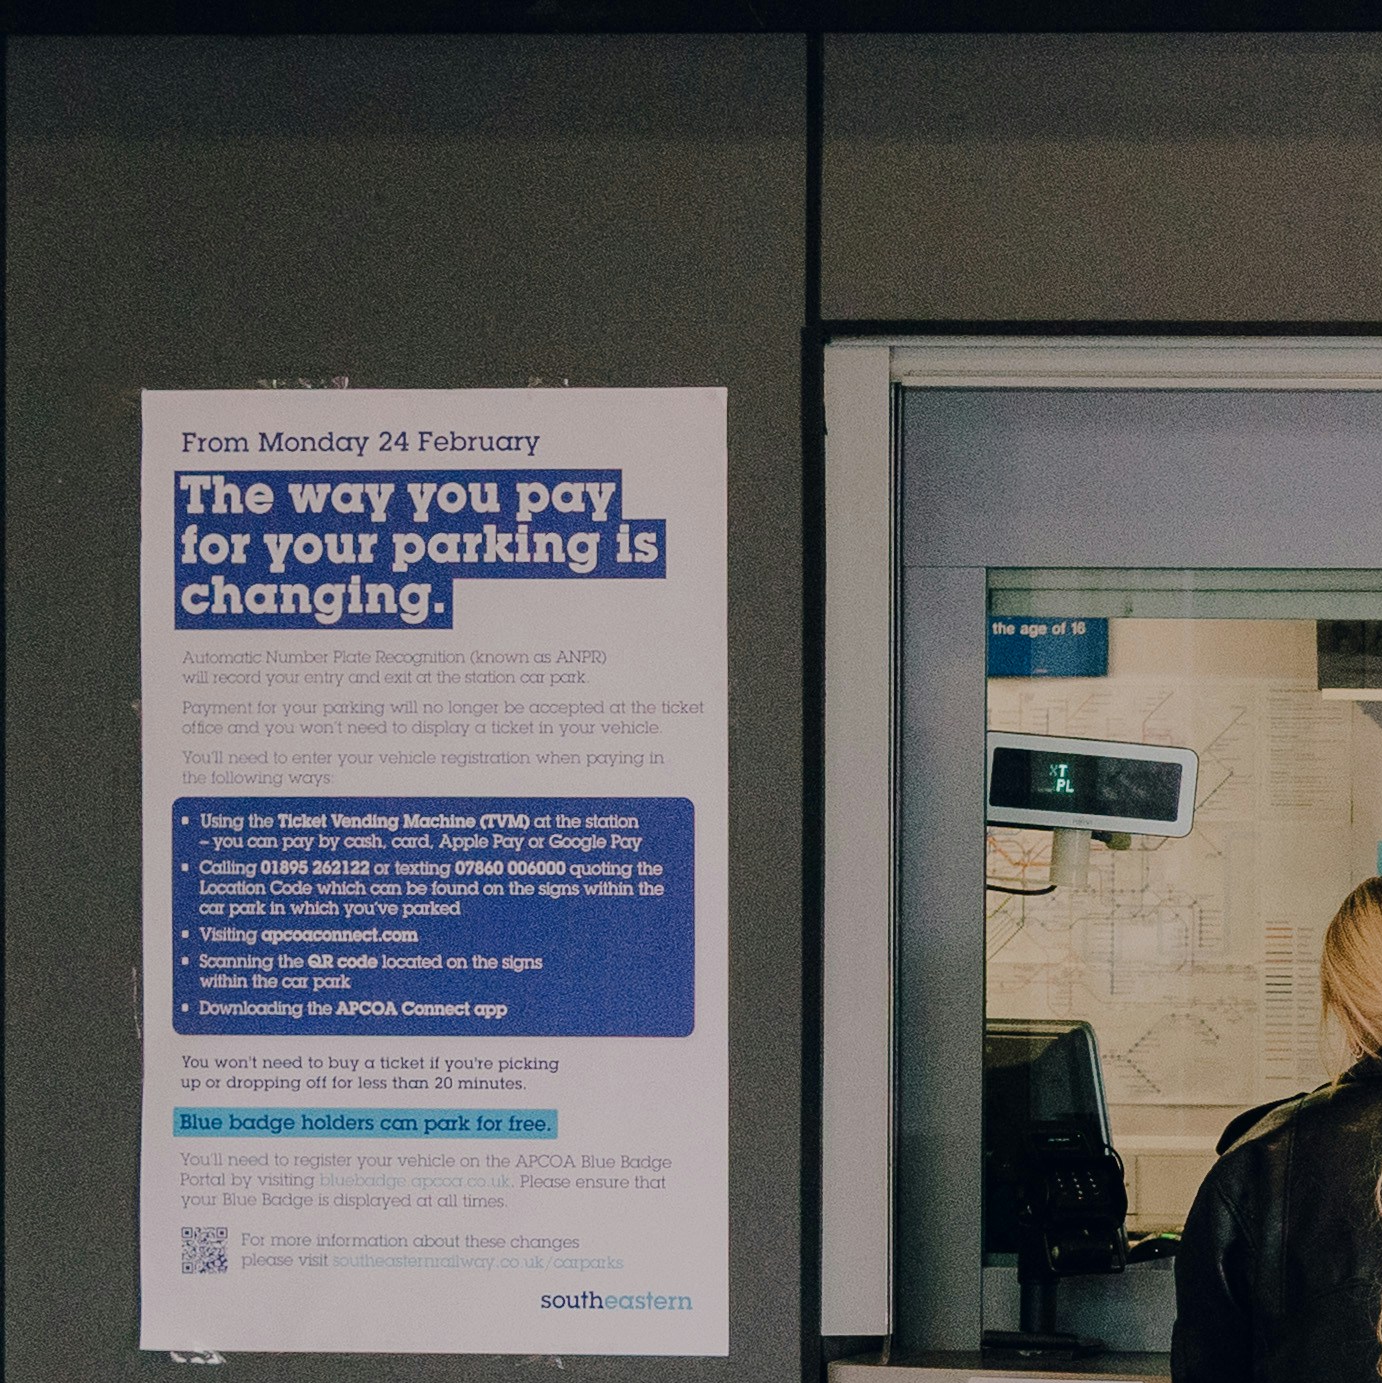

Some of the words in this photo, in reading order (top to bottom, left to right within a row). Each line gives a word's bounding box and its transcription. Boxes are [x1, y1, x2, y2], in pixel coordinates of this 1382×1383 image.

[181, 431, 250, 454] From
[258, 431, 370, 458] Monday
[378, 430, 409, 452] 24
[418, 430, 541, 457] February
[179, 474, 275, 515] The
[287, 482, 396, 523] way
[406, 481, 501, 523] you
[515, 481, 617, 523] pay
[181, 523, 251, 565] for
[262, 532, 379, 575] your
[391, 523, 601, 575] parking
[615, 523, 659, 564] is
[180, 574, 445, 625] changing.
[200, 813, 245, 832] Using
[248, 813, 274, 829] the
[277, 812, 328, 829] Ticket
[330, 813, 400, 832] Vending
[402, 813, 477, 829] Machine
[479, 813, 531, 831] (TVM)
[533, 814, 552, 829] at
[555, 813, 582, 829] the
[584, 814, 640, 829] station
[212, 836, 244, 852] you
[246, 836, 279, 849] can
[281, 836, 315, 852] pay
[318, 833, 341, 852] by
[343, 833, 387, 850] cash,
[390, 833, 434, 850] card,
[438, 833, 490, 852] Apple
[492, 833, 525, 853] Pay
[527, 836, 545, 849] or
[547, 833, 608, 853] Google
[610, 833, 644, 853] Pay
[198, 859, 258, 879] Calling
[260, 859, 309, 876] 01895
[312, 859, 371, 876] 262122
[373, 863, 391, 876] or
[394, 860, 452, 879] texting
[454, 859, 505, 876] 07860
[506, 859, 567, 876] 006000
[568, 861, 634, 881] quoting
[636, 861, 664, 876] the
[199, 926, 258, 947] Visiting
[260, 927, 419, 947] apcoaconnect.com
[199, 953, 274, 973] Scanning
[277, 953, 305, 969] the
[336, 953, 379, 970] code
[381, 954, 443, 970] located
[445, 956, 469, 970] on
[471, 954, 499, 970] the
[501, 955, 544, 973] signs
[199, 999, 304, 1019] Downloading
[306, 1000, 333, 1016] the
[335, 1000, 399, 1017] APCOA
[400, 1000, 471, 1017] Connect
[473, 1003, 509, 1020] app
[181, 1054, 210, 1070] You
[213, 1056, 258, 1070] won't
[262, 1055, 303, 1070] need
[307, 1056, 324, 1070] to
[327, 1055, 360, 1073] buy
[363, 1058, 376, 1070] a
[379, 1056, 425, 1070] ticket
[429, 1056, 440, 1070] if
[444, 1057, 494, 1074] you're
[497, 1056, 560, 1074] picking
[180, 1077, 202, 1092] up
[204, 1077, 222, 1089] or
[225, 1075, 302, 1093] dropping
[305, 1075, 328, 1090] off
[331, 1075, 353, 1090] for
[357, 1076, 388, 1090] less
[391, 1076, 430, 1090] than
[434, 1075, 454, 1090] 20
[457, 1077, 524, 1091] minutes.
[178, 1112, 224, 1131] Blue
[228, 1113, 296, 1136] badge
[301, 1113, 375, 1131] holders
[379, 1117, 419, 1132] can
[423, 1114, 471, 1136] park
[476, 1114, 503, 1132] for
[508, 1114, 551, 1133] free.
[540, 1290, 692, 1310] southeastern
